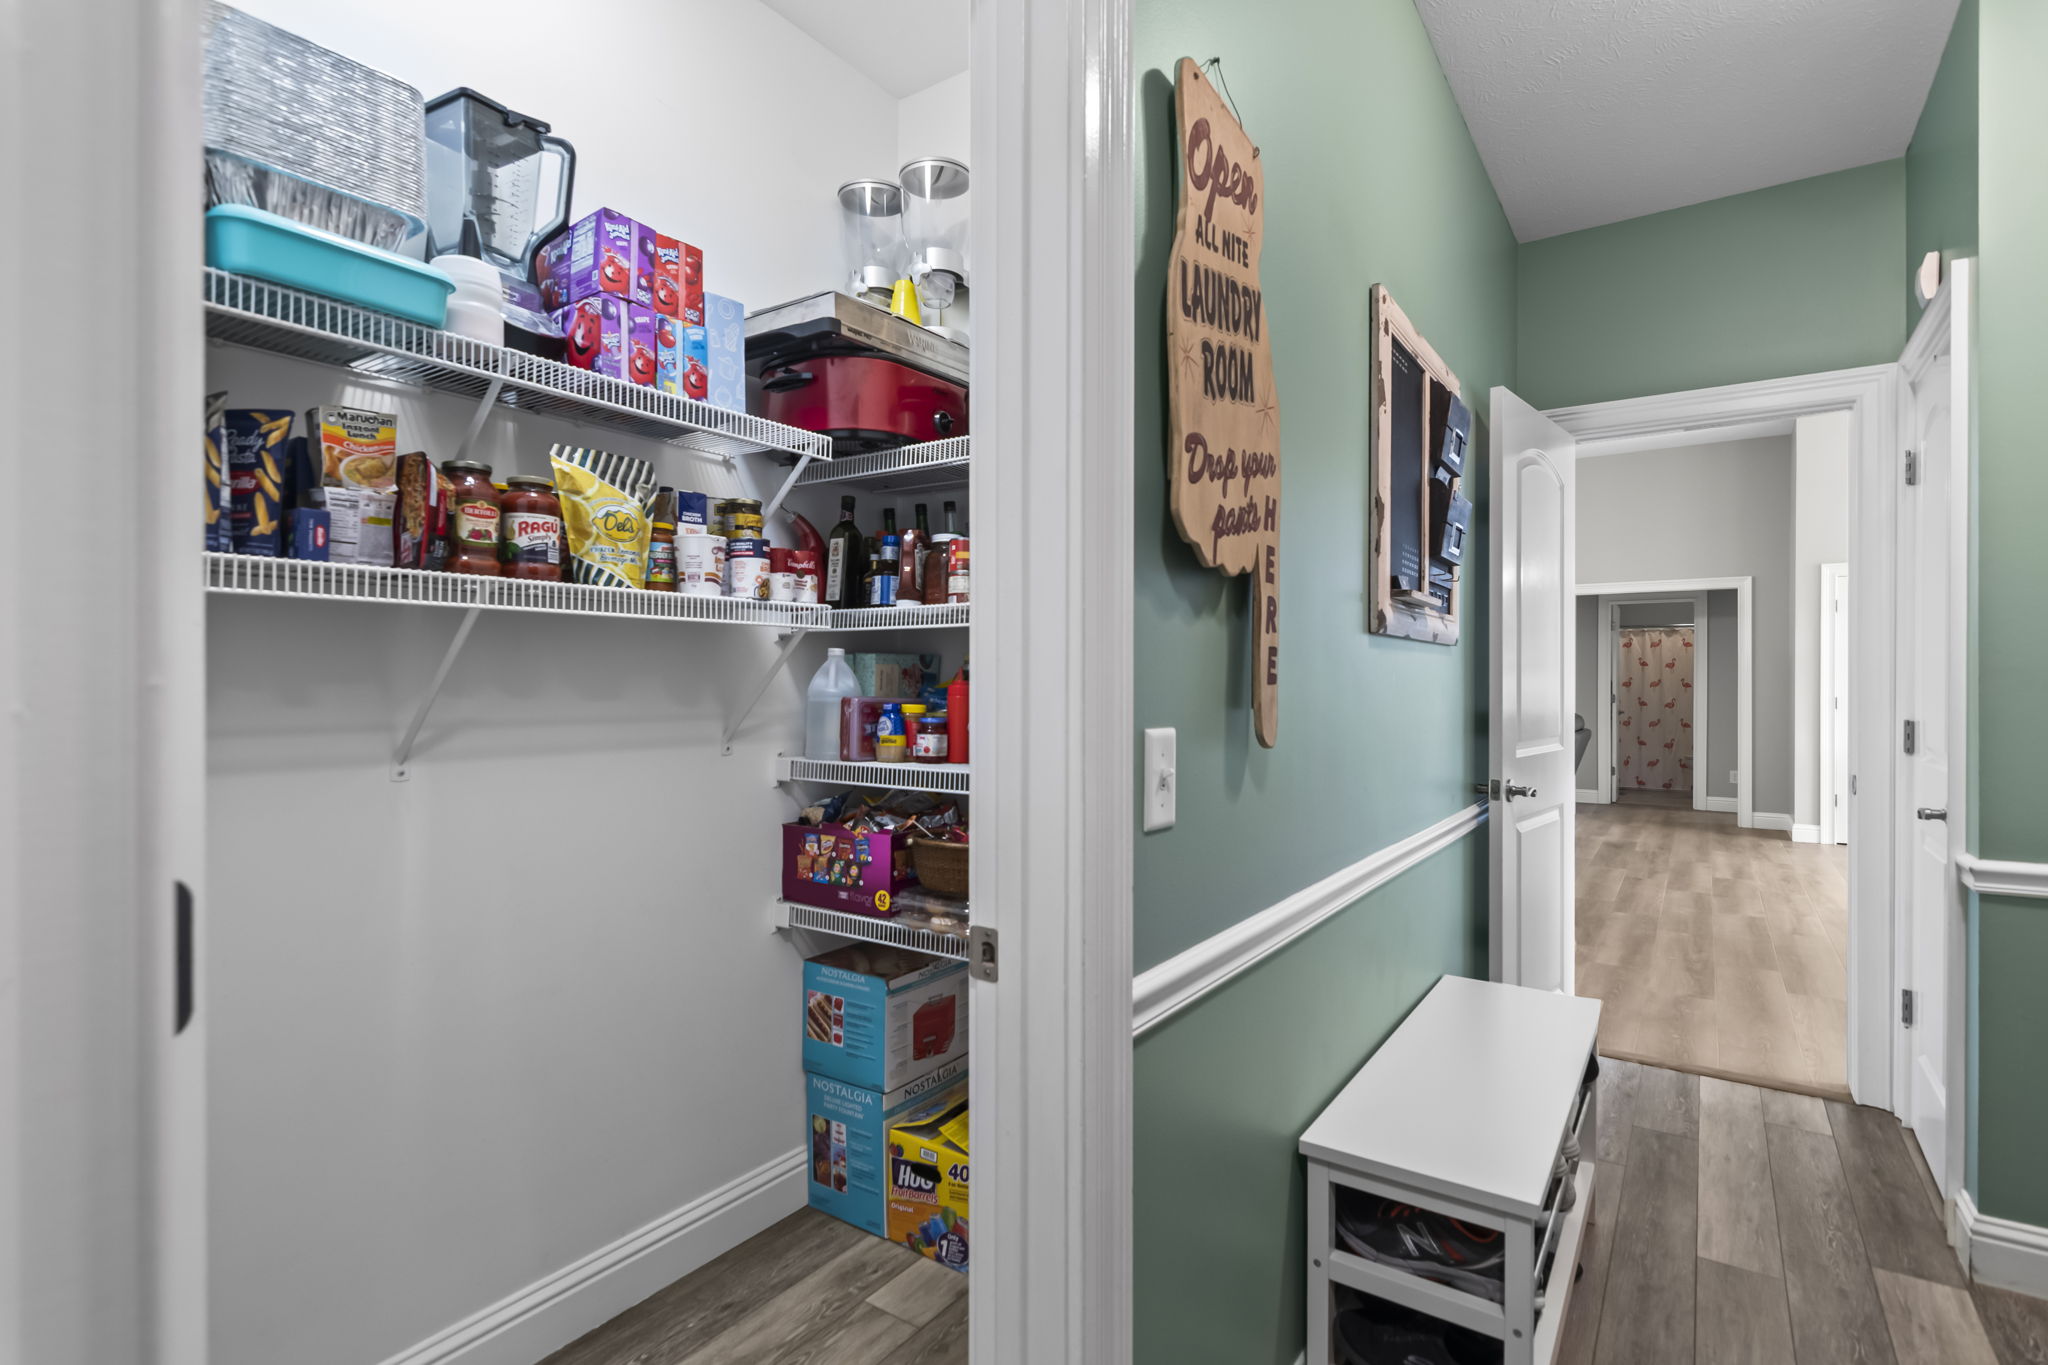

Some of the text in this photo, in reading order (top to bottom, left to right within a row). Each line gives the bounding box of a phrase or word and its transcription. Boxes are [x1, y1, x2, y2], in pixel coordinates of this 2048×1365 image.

[1187, 117, 1258, 222] Open
[1195, 214, 1249, 268] ALL NITE
[1180, 256, 1262, 343] LAUNDRY
[1201, 338, 1254, 402] ROOM
[337, 411, 393, 427] Maruchan
[347, 430, 377, 440] Lunch
[1185, 432, 1276, 499] Drop your
[1212, 495, 1261, 565] pants
[821, 967, 866, 984] NOSTALGIA
[813, 1078, 873, 1106] NOSTALGIA
[948, 1163, 969, 1183] 40
[891, 1202, 914, 1213] Original
